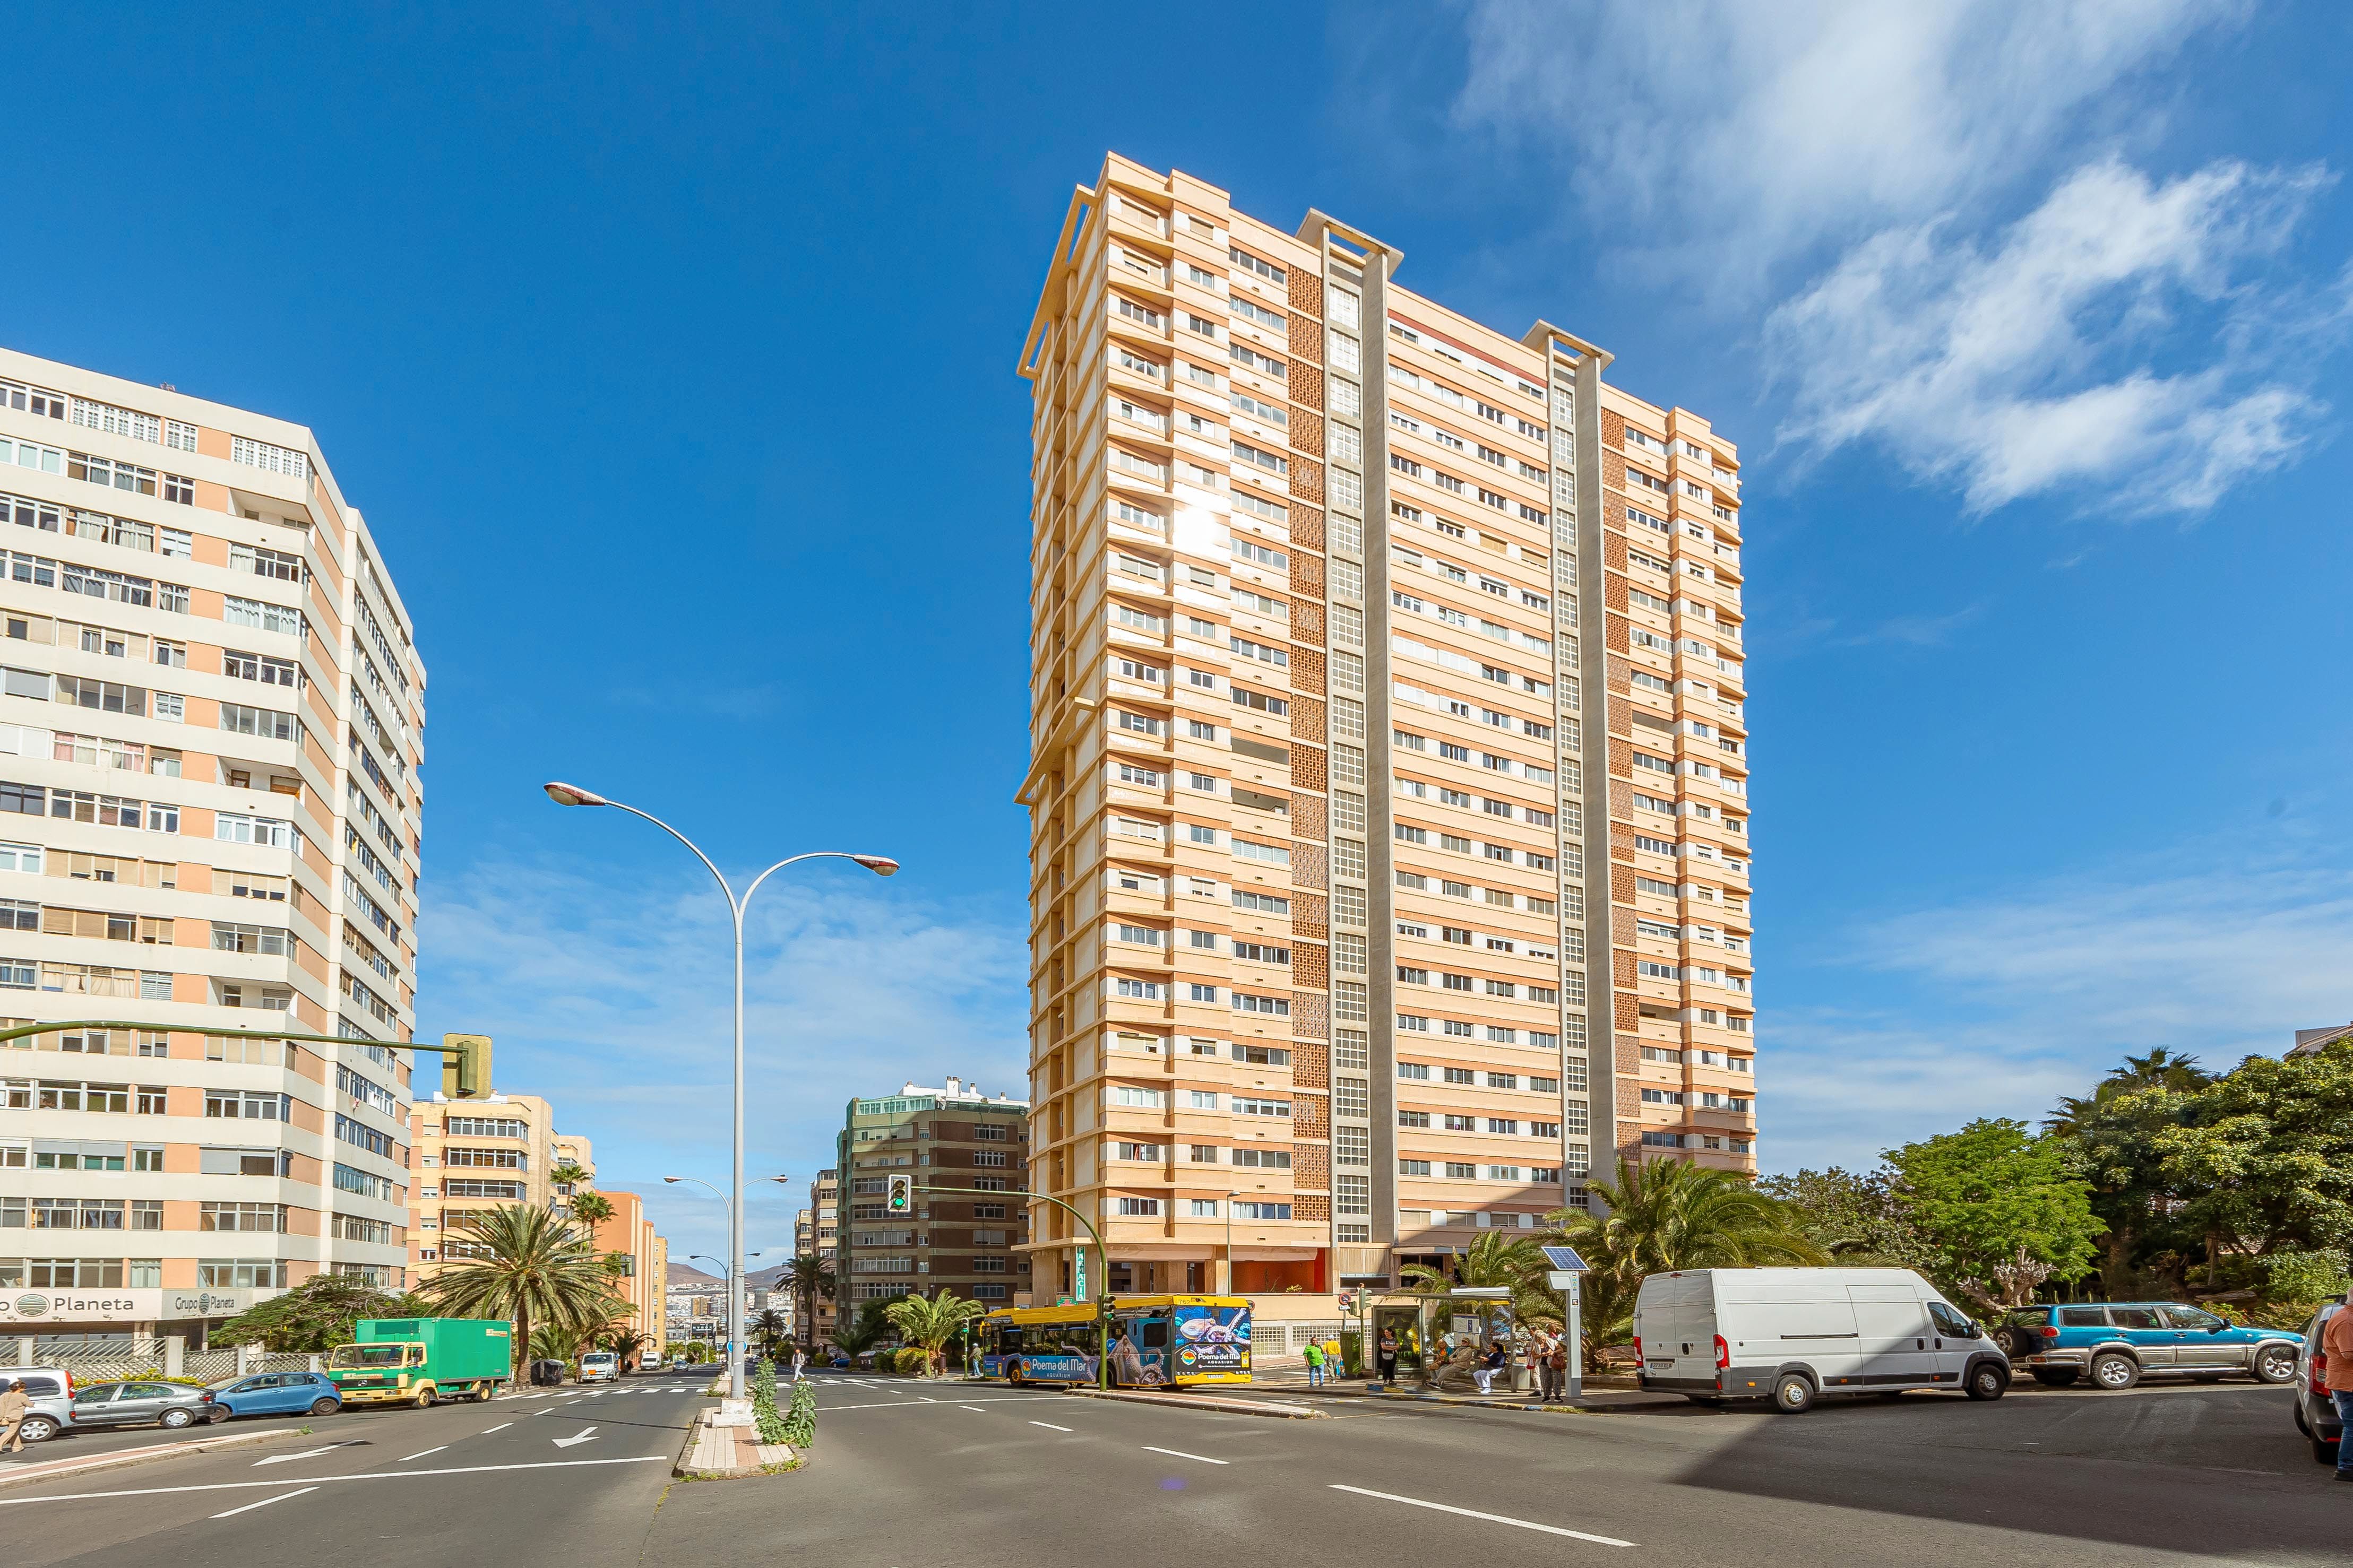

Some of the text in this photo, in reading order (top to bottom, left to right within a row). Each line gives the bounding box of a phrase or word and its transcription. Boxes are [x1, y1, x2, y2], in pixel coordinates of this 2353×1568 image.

[55, 1296, 133, 1311] Planeta
[175, 1296, 235, 1313] Grupo Planeta
[1032, 1358, 1087, 1371] Poema del Mar
